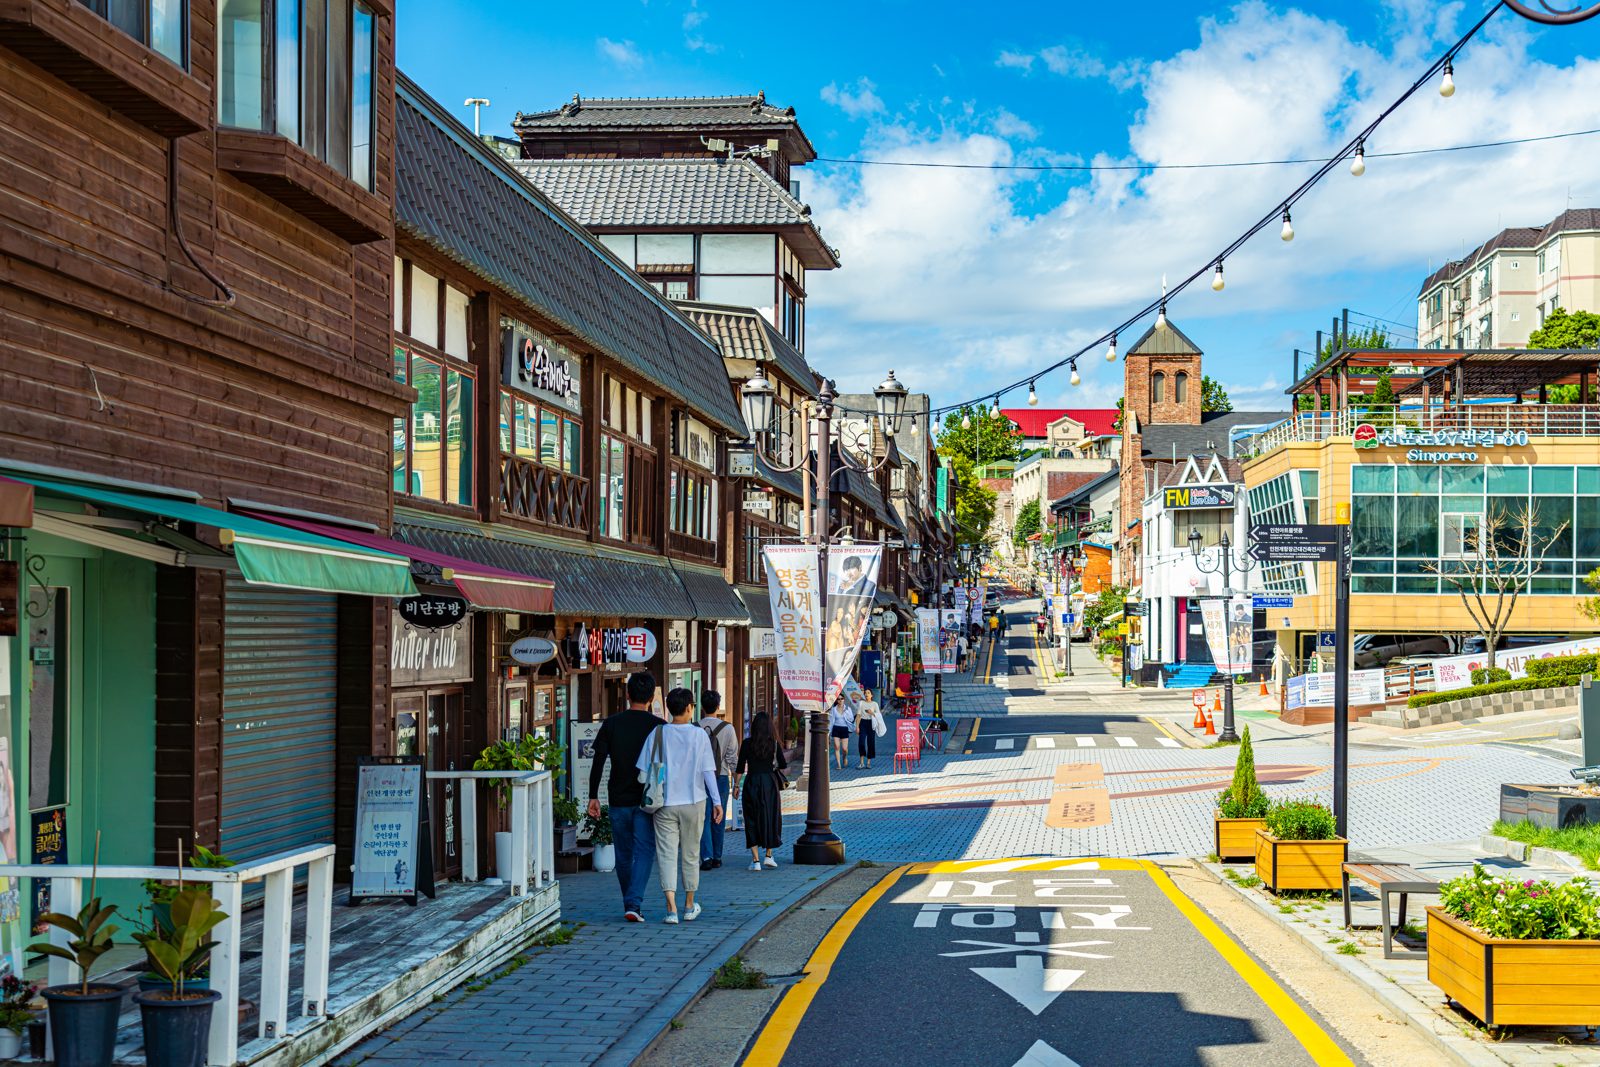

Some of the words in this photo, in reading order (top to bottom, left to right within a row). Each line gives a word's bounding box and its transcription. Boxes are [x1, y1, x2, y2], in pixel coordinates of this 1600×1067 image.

[1502, 430, 1529, 447] 80
[1407, 448, 1478, 463] Sinpo-ro
[1166, 488, 1189, 507] FM
[1190, 488, 1210, 497] Music
[776, 568, 811, 589] 영종
[405, 601, 462, 617] 비단공방
[777, 591, 813, 611] 세계
[780, 613, 815, 635] 음식
[391, 624, 431, 671] butter
[432, 626, 457, 670] club
[627, 632, 648, 658] 떡
[783, 634, 815, 657] 축제
[1439, 665, 1456, 673] 2024
[373, 849, 398, 857] 비단공방
[382, 840, 401, 848] 가득한
[912, 903, 1152, 931] 진입
